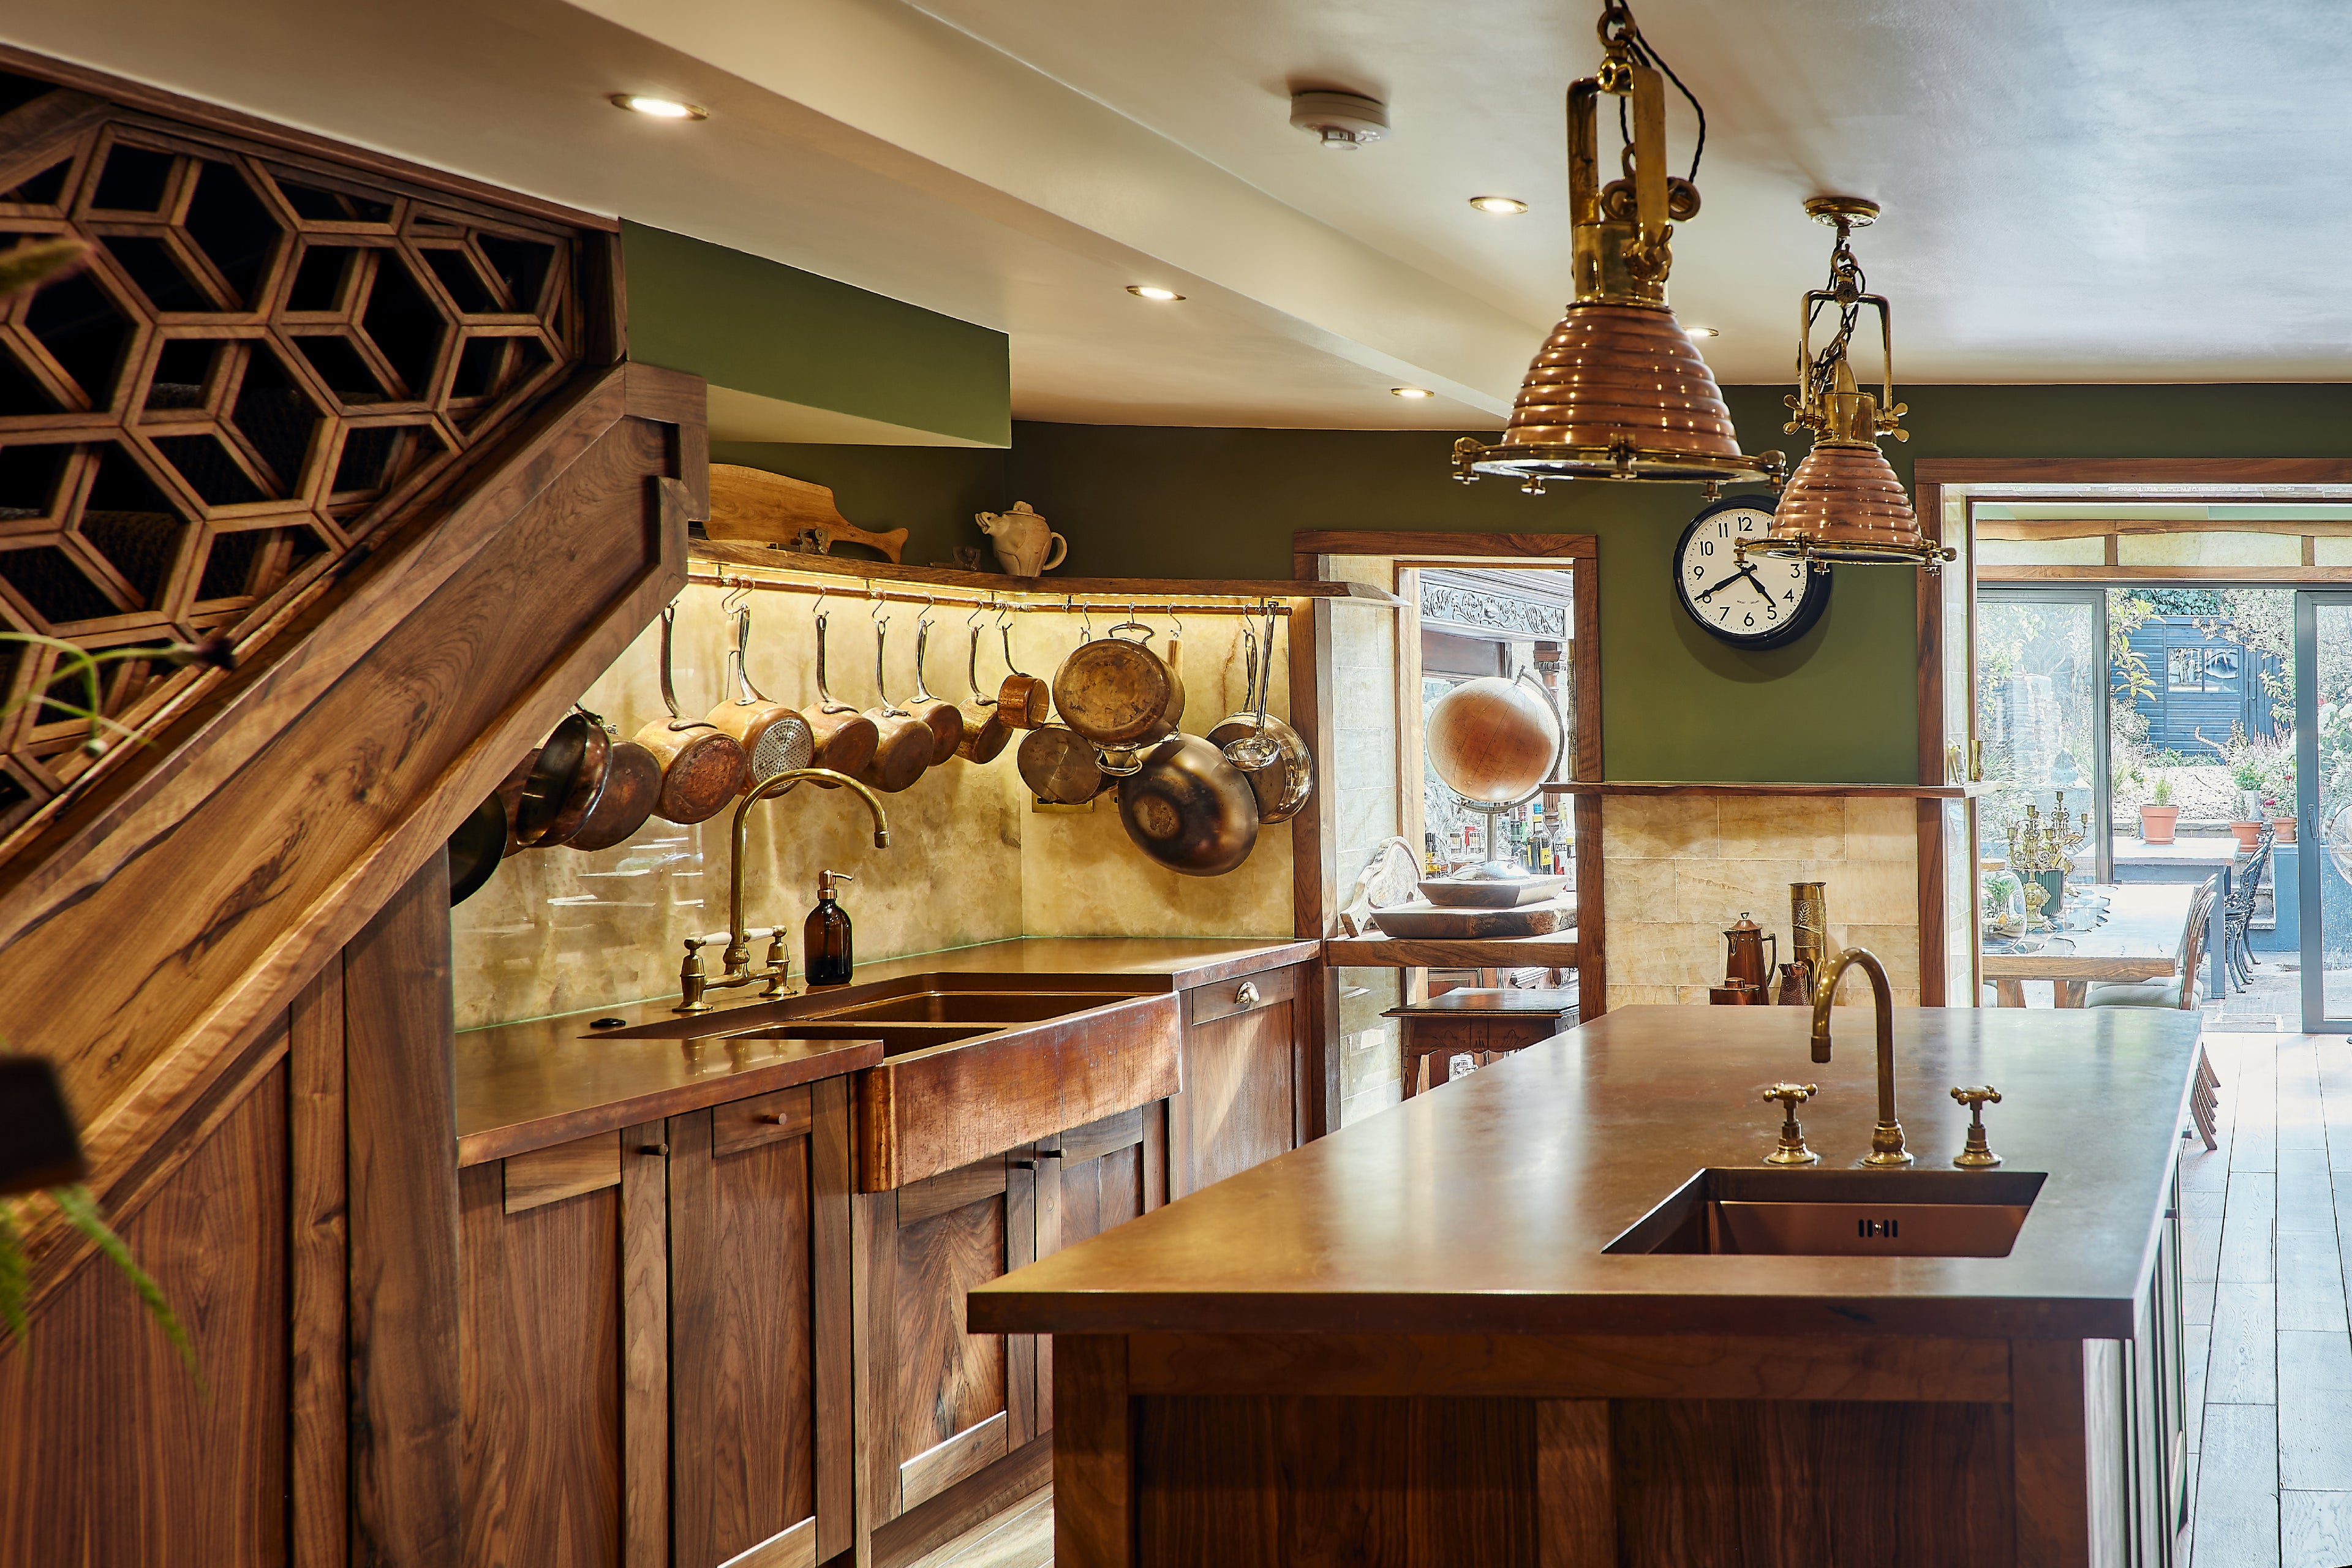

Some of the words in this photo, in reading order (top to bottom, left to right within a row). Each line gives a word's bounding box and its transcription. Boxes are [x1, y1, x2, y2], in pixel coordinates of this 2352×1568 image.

[1718, 522, 1728, 538] 11
[1738, 516, 1752, 531] 12
[1700, 541, 1714, 556] 10
[1693, 565, 1704, 580] 9
[1790, 564, 1801, 578] 3
[1702, 589, 1712, 603] 8
[1782, 588, 1795, 602] 4
[1719, 606, 1730, 621] 7
[1743, 612, 1754, 627] 6
[1767, 605, 1777, 620] 5
